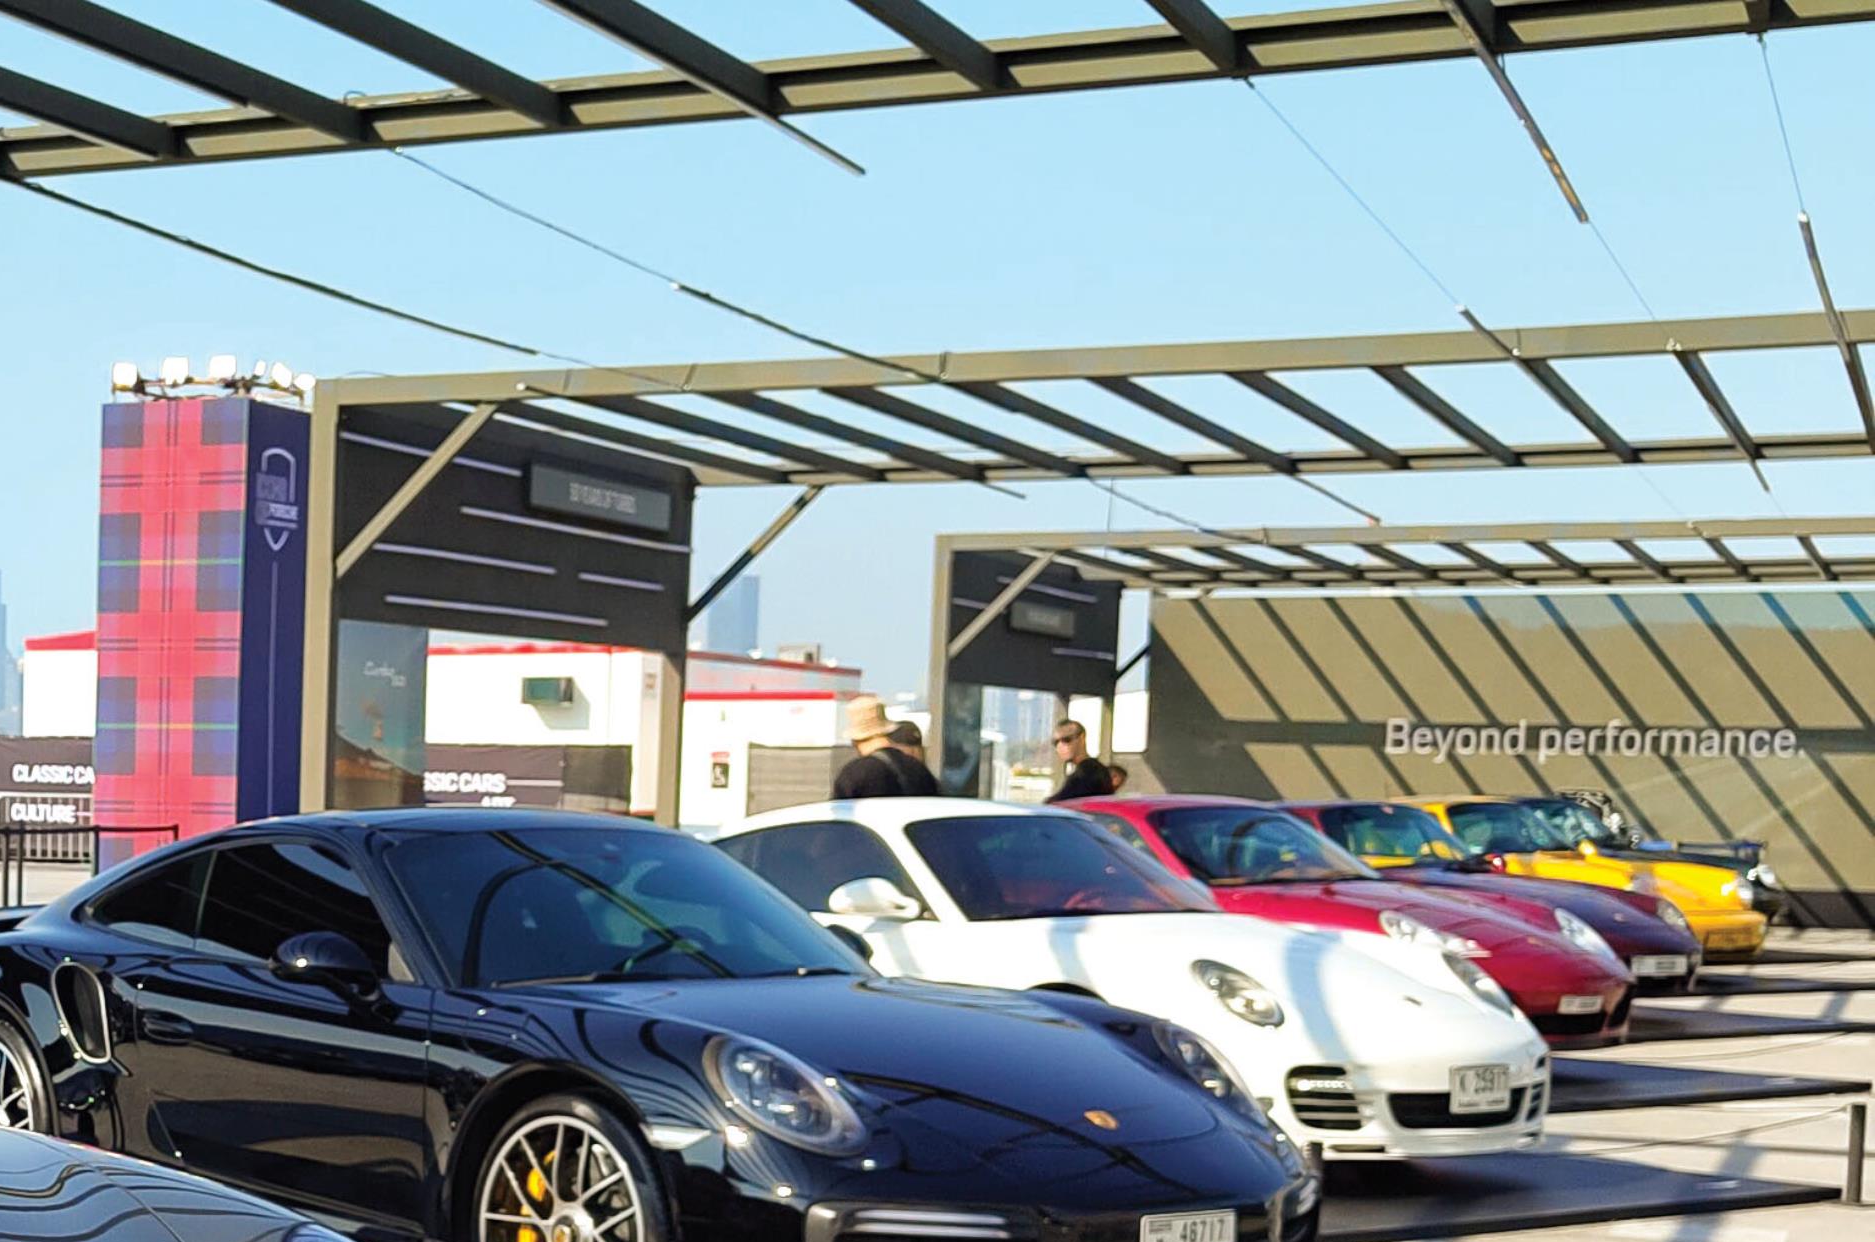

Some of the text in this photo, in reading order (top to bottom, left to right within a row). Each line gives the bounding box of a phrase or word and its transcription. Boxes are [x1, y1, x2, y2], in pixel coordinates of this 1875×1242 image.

[1385, 718, 1806, 764] Beyond performance.
[12, 763, 96, 785] CLASSIC CA
[423, 771, 507, 794] SSIC CARS
[11, 802, 77, 824] CULTURE
